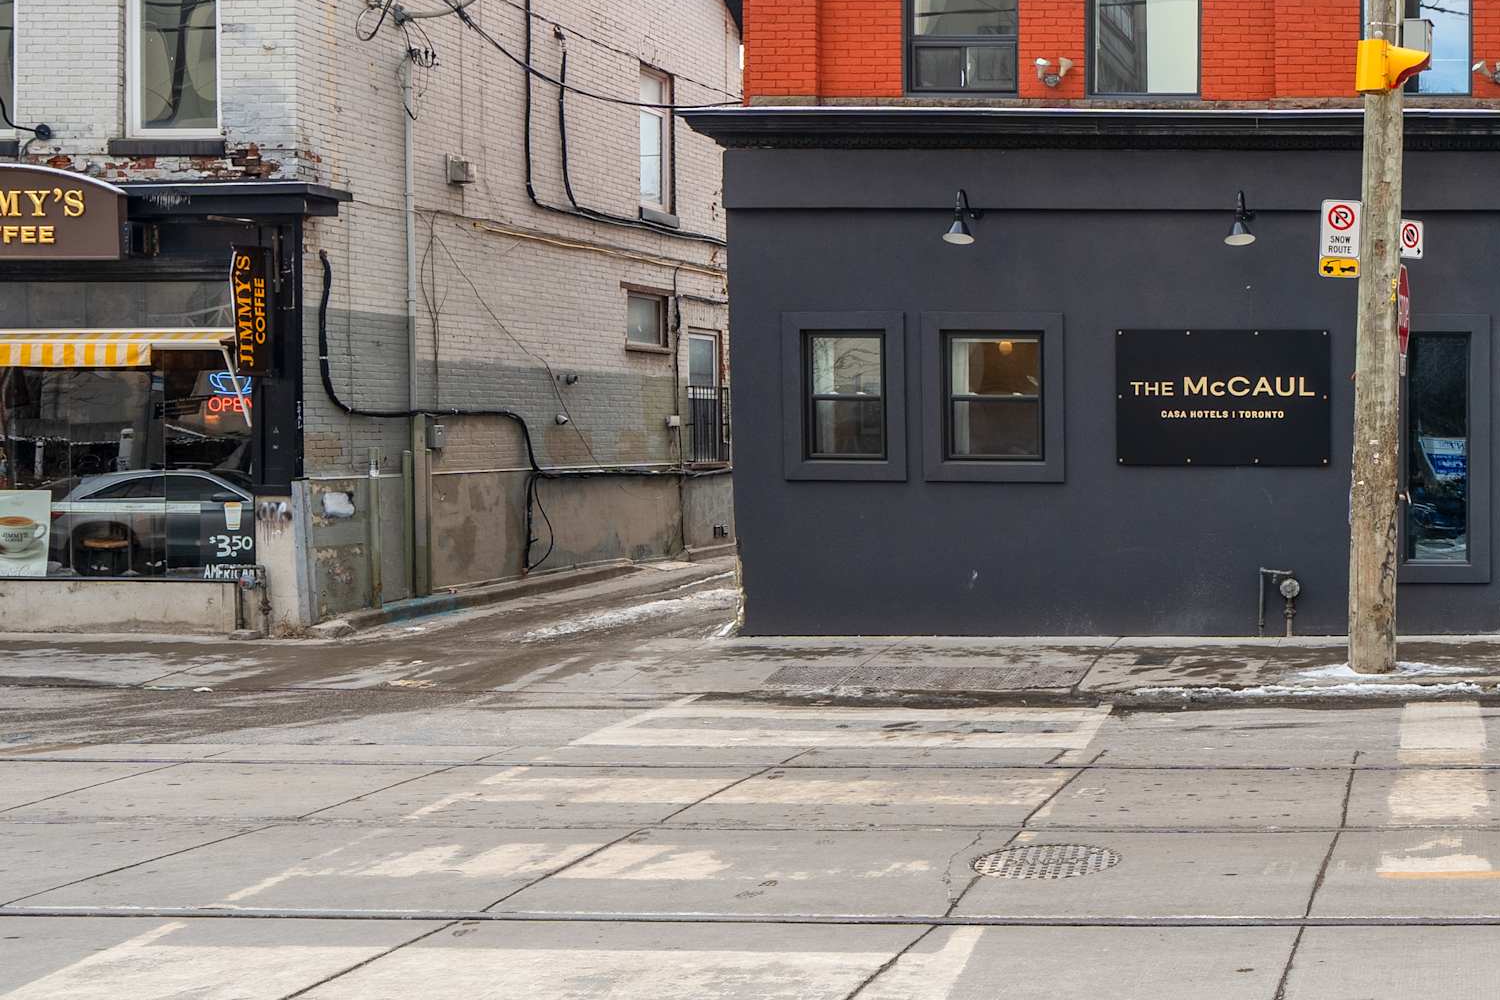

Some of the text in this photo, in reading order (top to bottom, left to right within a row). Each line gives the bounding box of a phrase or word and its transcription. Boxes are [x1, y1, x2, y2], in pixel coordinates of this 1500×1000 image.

[0, 226, 55, 244] FEE
[1330, 235, 1351, 243] SNOW
[1328, 245, 1352, 254] ROUTE
[236, 255, 254, 367] JIMMY'S
[254, 277, 266, 345] COFFEE
[1130, 376, 1316, 397] THE McCAUL
[1161, 410, 1285, 419] CASA HOTELS TORONTO
[208, 534, 254, 558] $3.50
